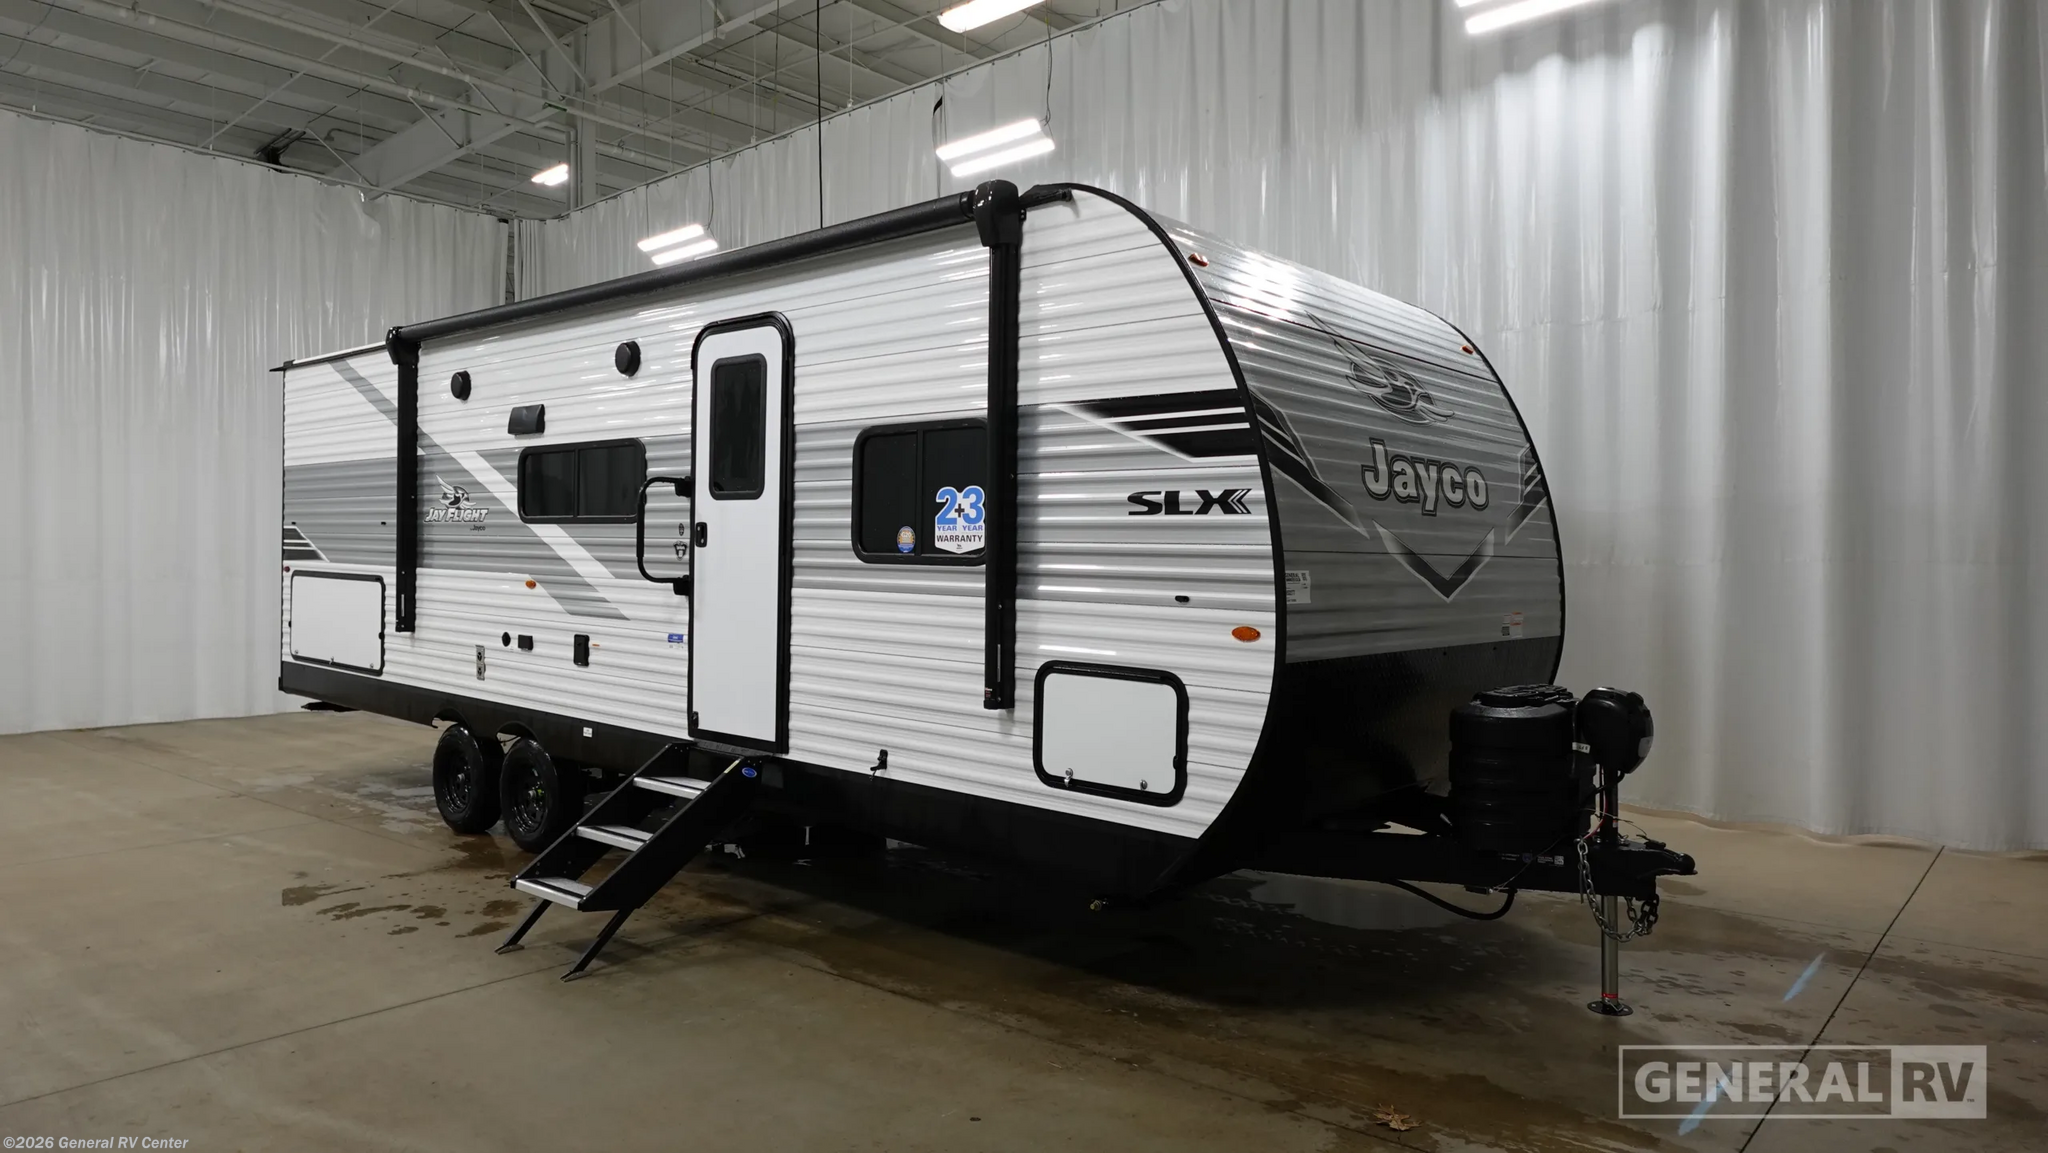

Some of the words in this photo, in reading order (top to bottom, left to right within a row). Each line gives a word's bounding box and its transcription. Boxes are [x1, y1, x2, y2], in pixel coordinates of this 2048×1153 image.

[1361, 437, 1489, 516] Jayco
[424, 508, 446, 522] JAY
[445, 507, 489, 522] FLIGHT
[1127, 488, 1252, 515] SLX
